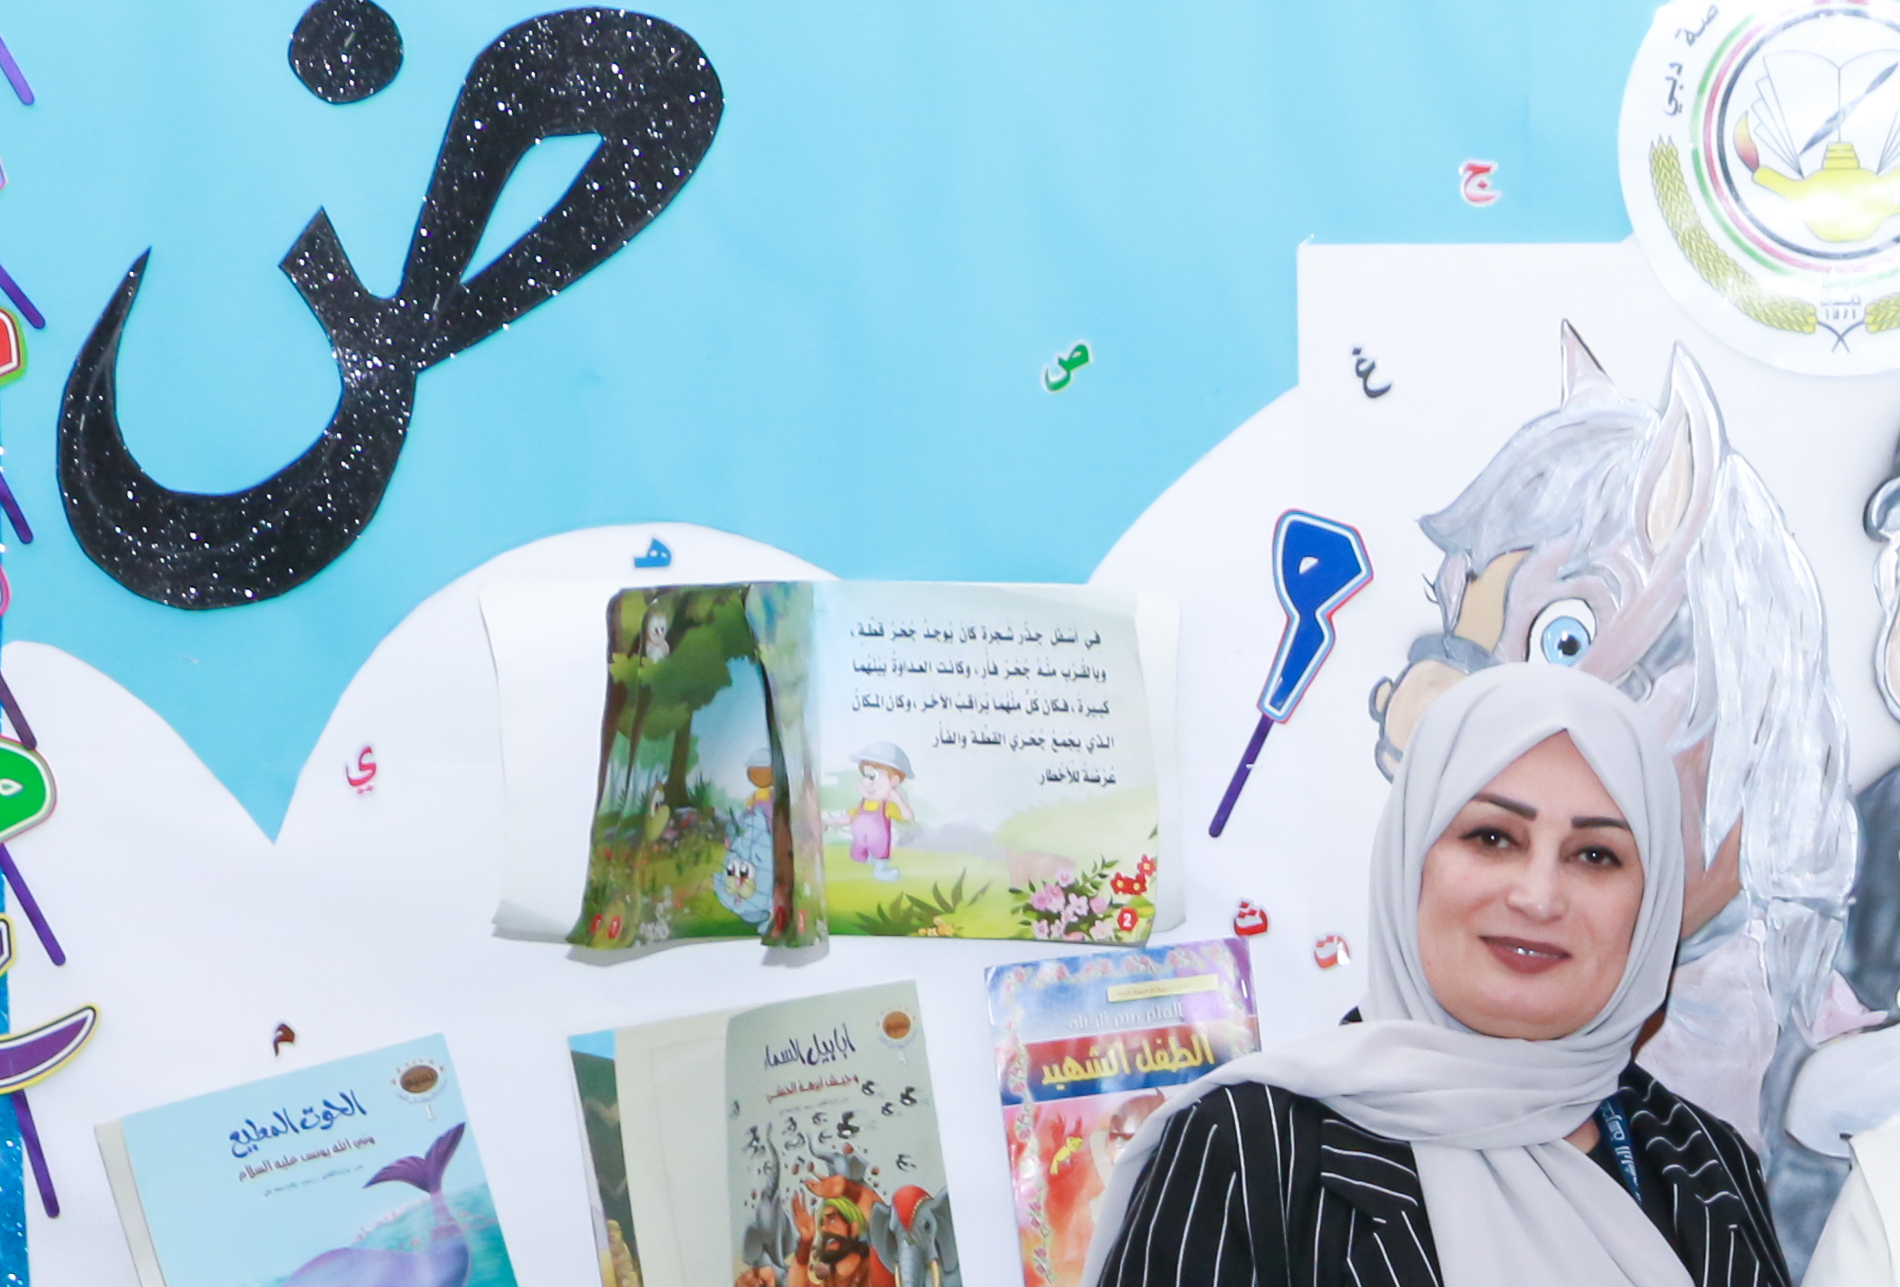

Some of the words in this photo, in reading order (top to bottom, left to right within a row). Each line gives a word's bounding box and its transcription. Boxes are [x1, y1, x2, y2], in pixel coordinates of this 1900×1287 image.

[1461, 161, 1500, 204] ج
[57, 0, 724, 611] ض
[1044, 343, 1090, 392] ص
[1352, 346, 1393, 399] غ
[345, 743, 378, 796] ي
[1122, 912, 1133, 928] 2
[1233, 900, 1268, 937] ث
[272, 1022, 295, 1058] م
[1135, 1033, 1216, 1074] الطفل
[1041, 1040, 1132, 1092] الشهيد
[228, 1107, 300, 1159] المطيع
[299, 1089, 367, 1131] الحوت
